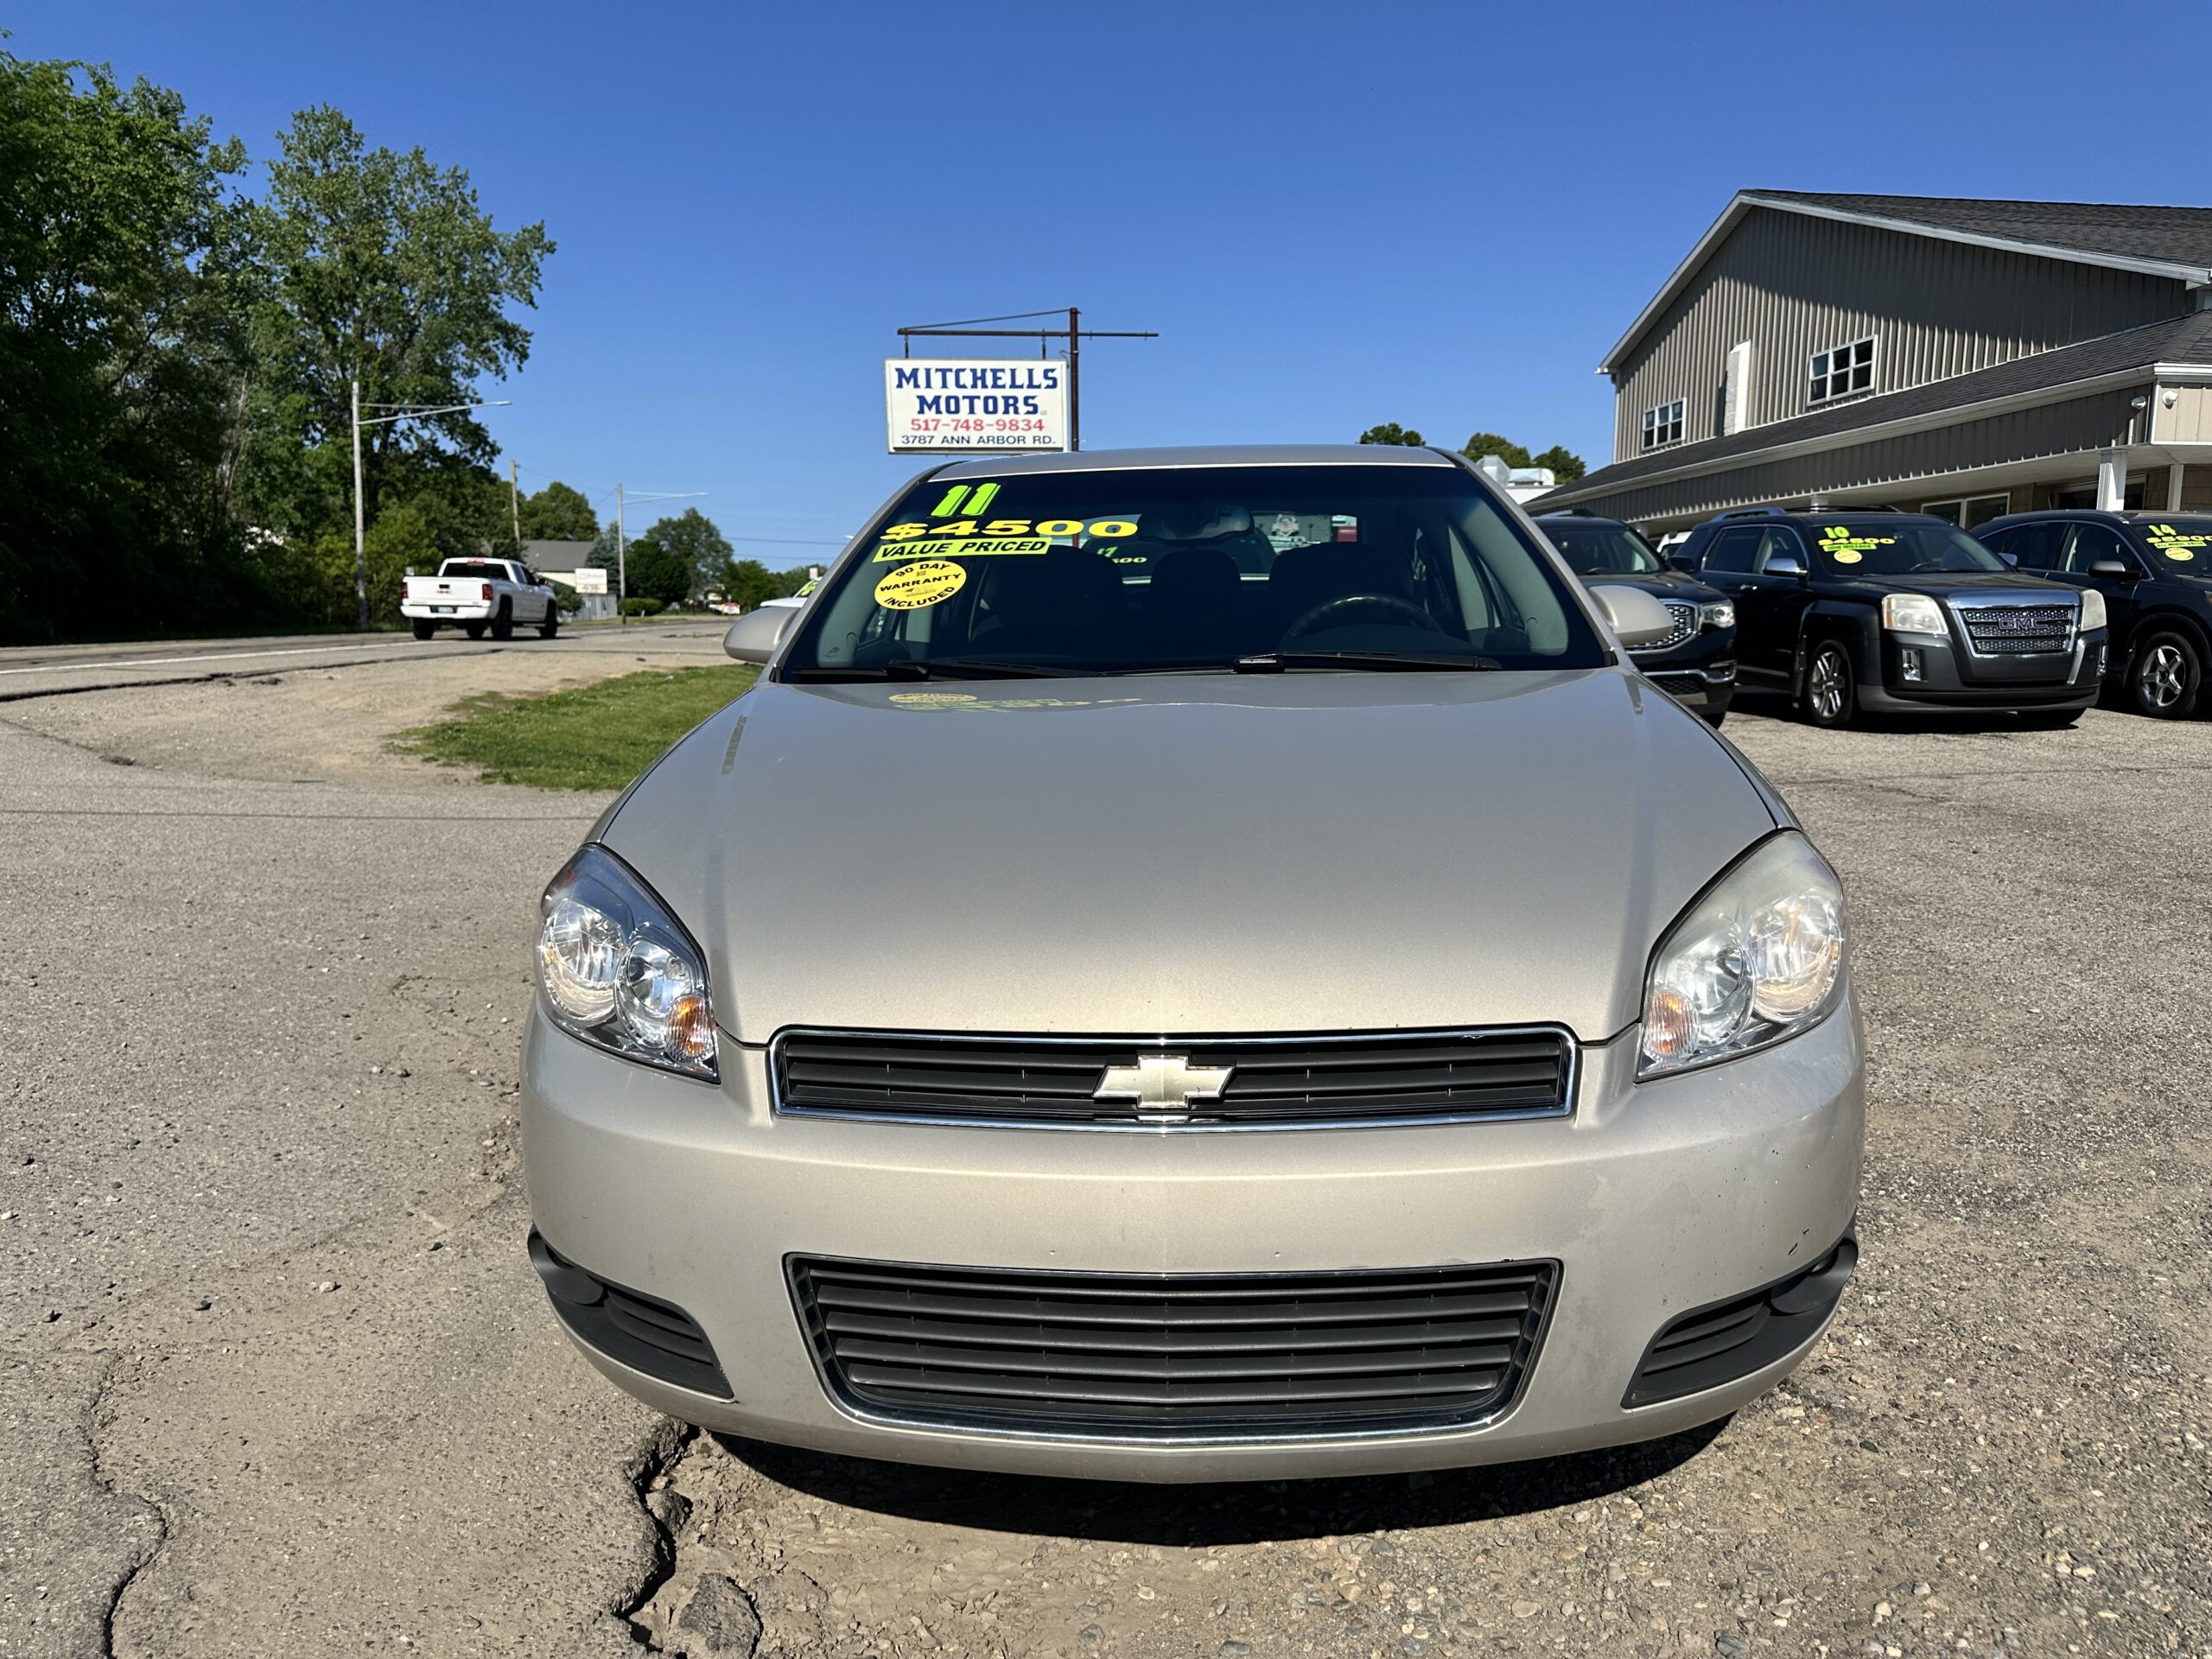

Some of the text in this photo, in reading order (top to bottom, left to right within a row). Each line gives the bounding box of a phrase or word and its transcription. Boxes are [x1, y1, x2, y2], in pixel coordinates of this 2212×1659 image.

[895, 368, 1058, 389] MITCHELLS
[917, 396, 1039, 415] MOTORS
[911, 419, 1045, 430] 517-748-9834
[901, 435, 1056, 444] 3787 ANN ARBOR RD.
[929, 483, 1001, 518] 11
[880, 519, 1138, 540] $4500
[1824, 526, 1850, 538] 10
[2148, 524, 2177, 536] 14
[881, 541, 1046, 558] VALUE PRICED
[895, 567, 913, 577] 90
[880, 573, 962, 592] WARRANTY
[884, 587, 955, 607] INCLUDED
[1999, 617, 2048, 629] GMC
